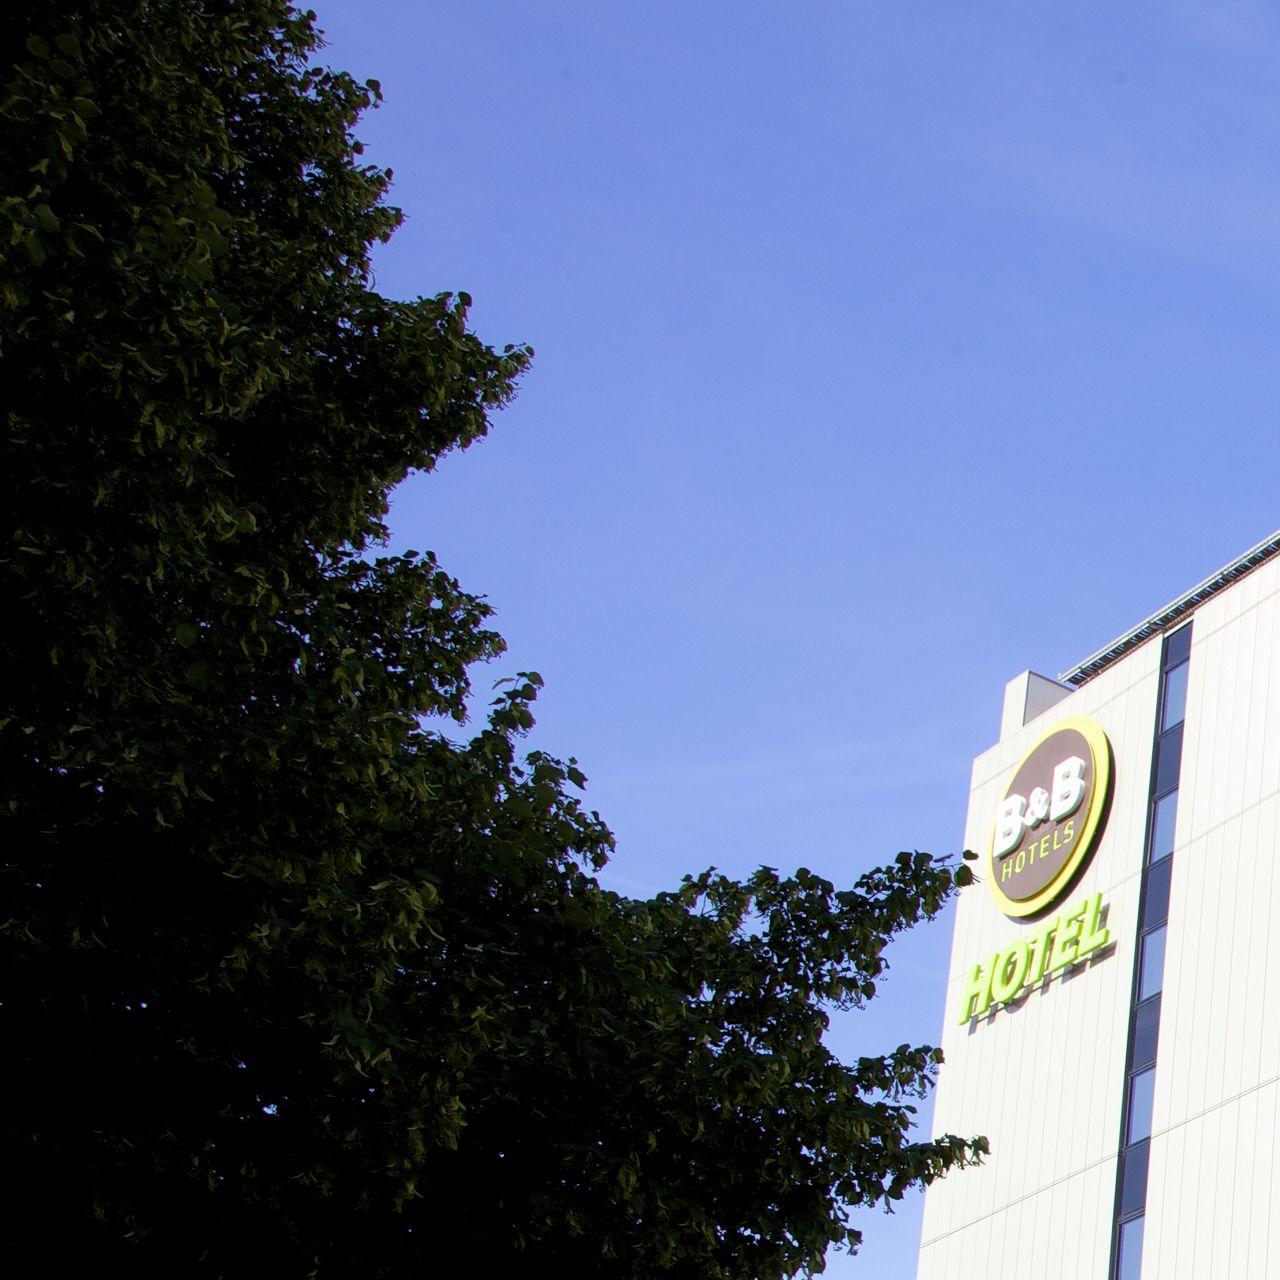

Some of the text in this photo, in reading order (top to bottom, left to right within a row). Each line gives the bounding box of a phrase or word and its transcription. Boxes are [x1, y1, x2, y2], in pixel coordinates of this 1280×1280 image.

[992, 755, 1086, 859] B&B
[1001, 819, 1076, 883] HOTELS
[958, 891, 1110, 1026] HOTEL
